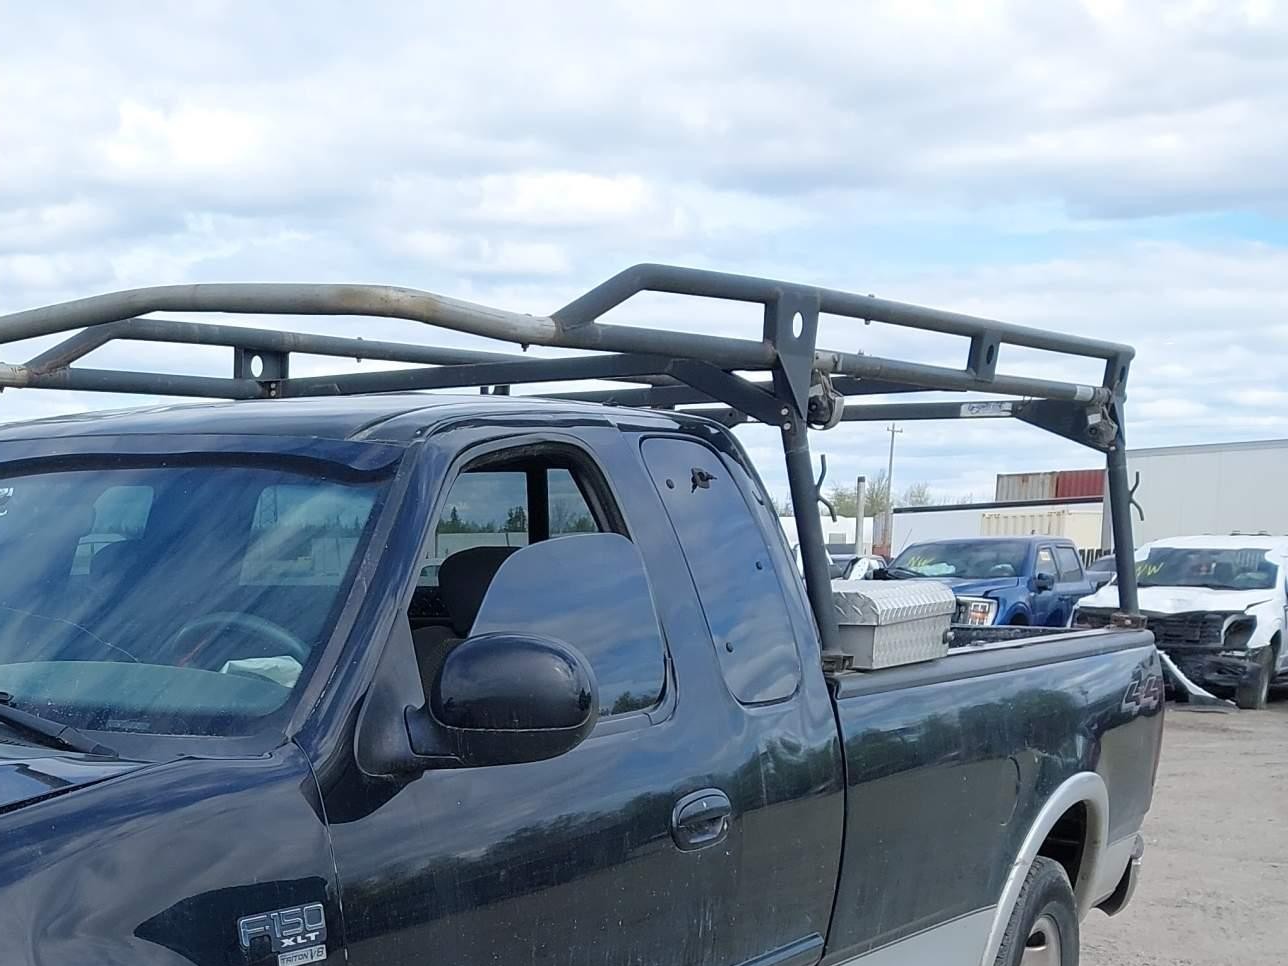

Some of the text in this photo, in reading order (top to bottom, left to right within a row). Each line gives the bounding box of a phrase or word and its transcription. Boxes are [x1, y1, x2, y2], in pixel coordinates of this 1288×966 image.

[240, 903, 325, 947] F-150
[279, 931, 320, 948] XLT
[280, 947, 324, 964] TRITON V8
